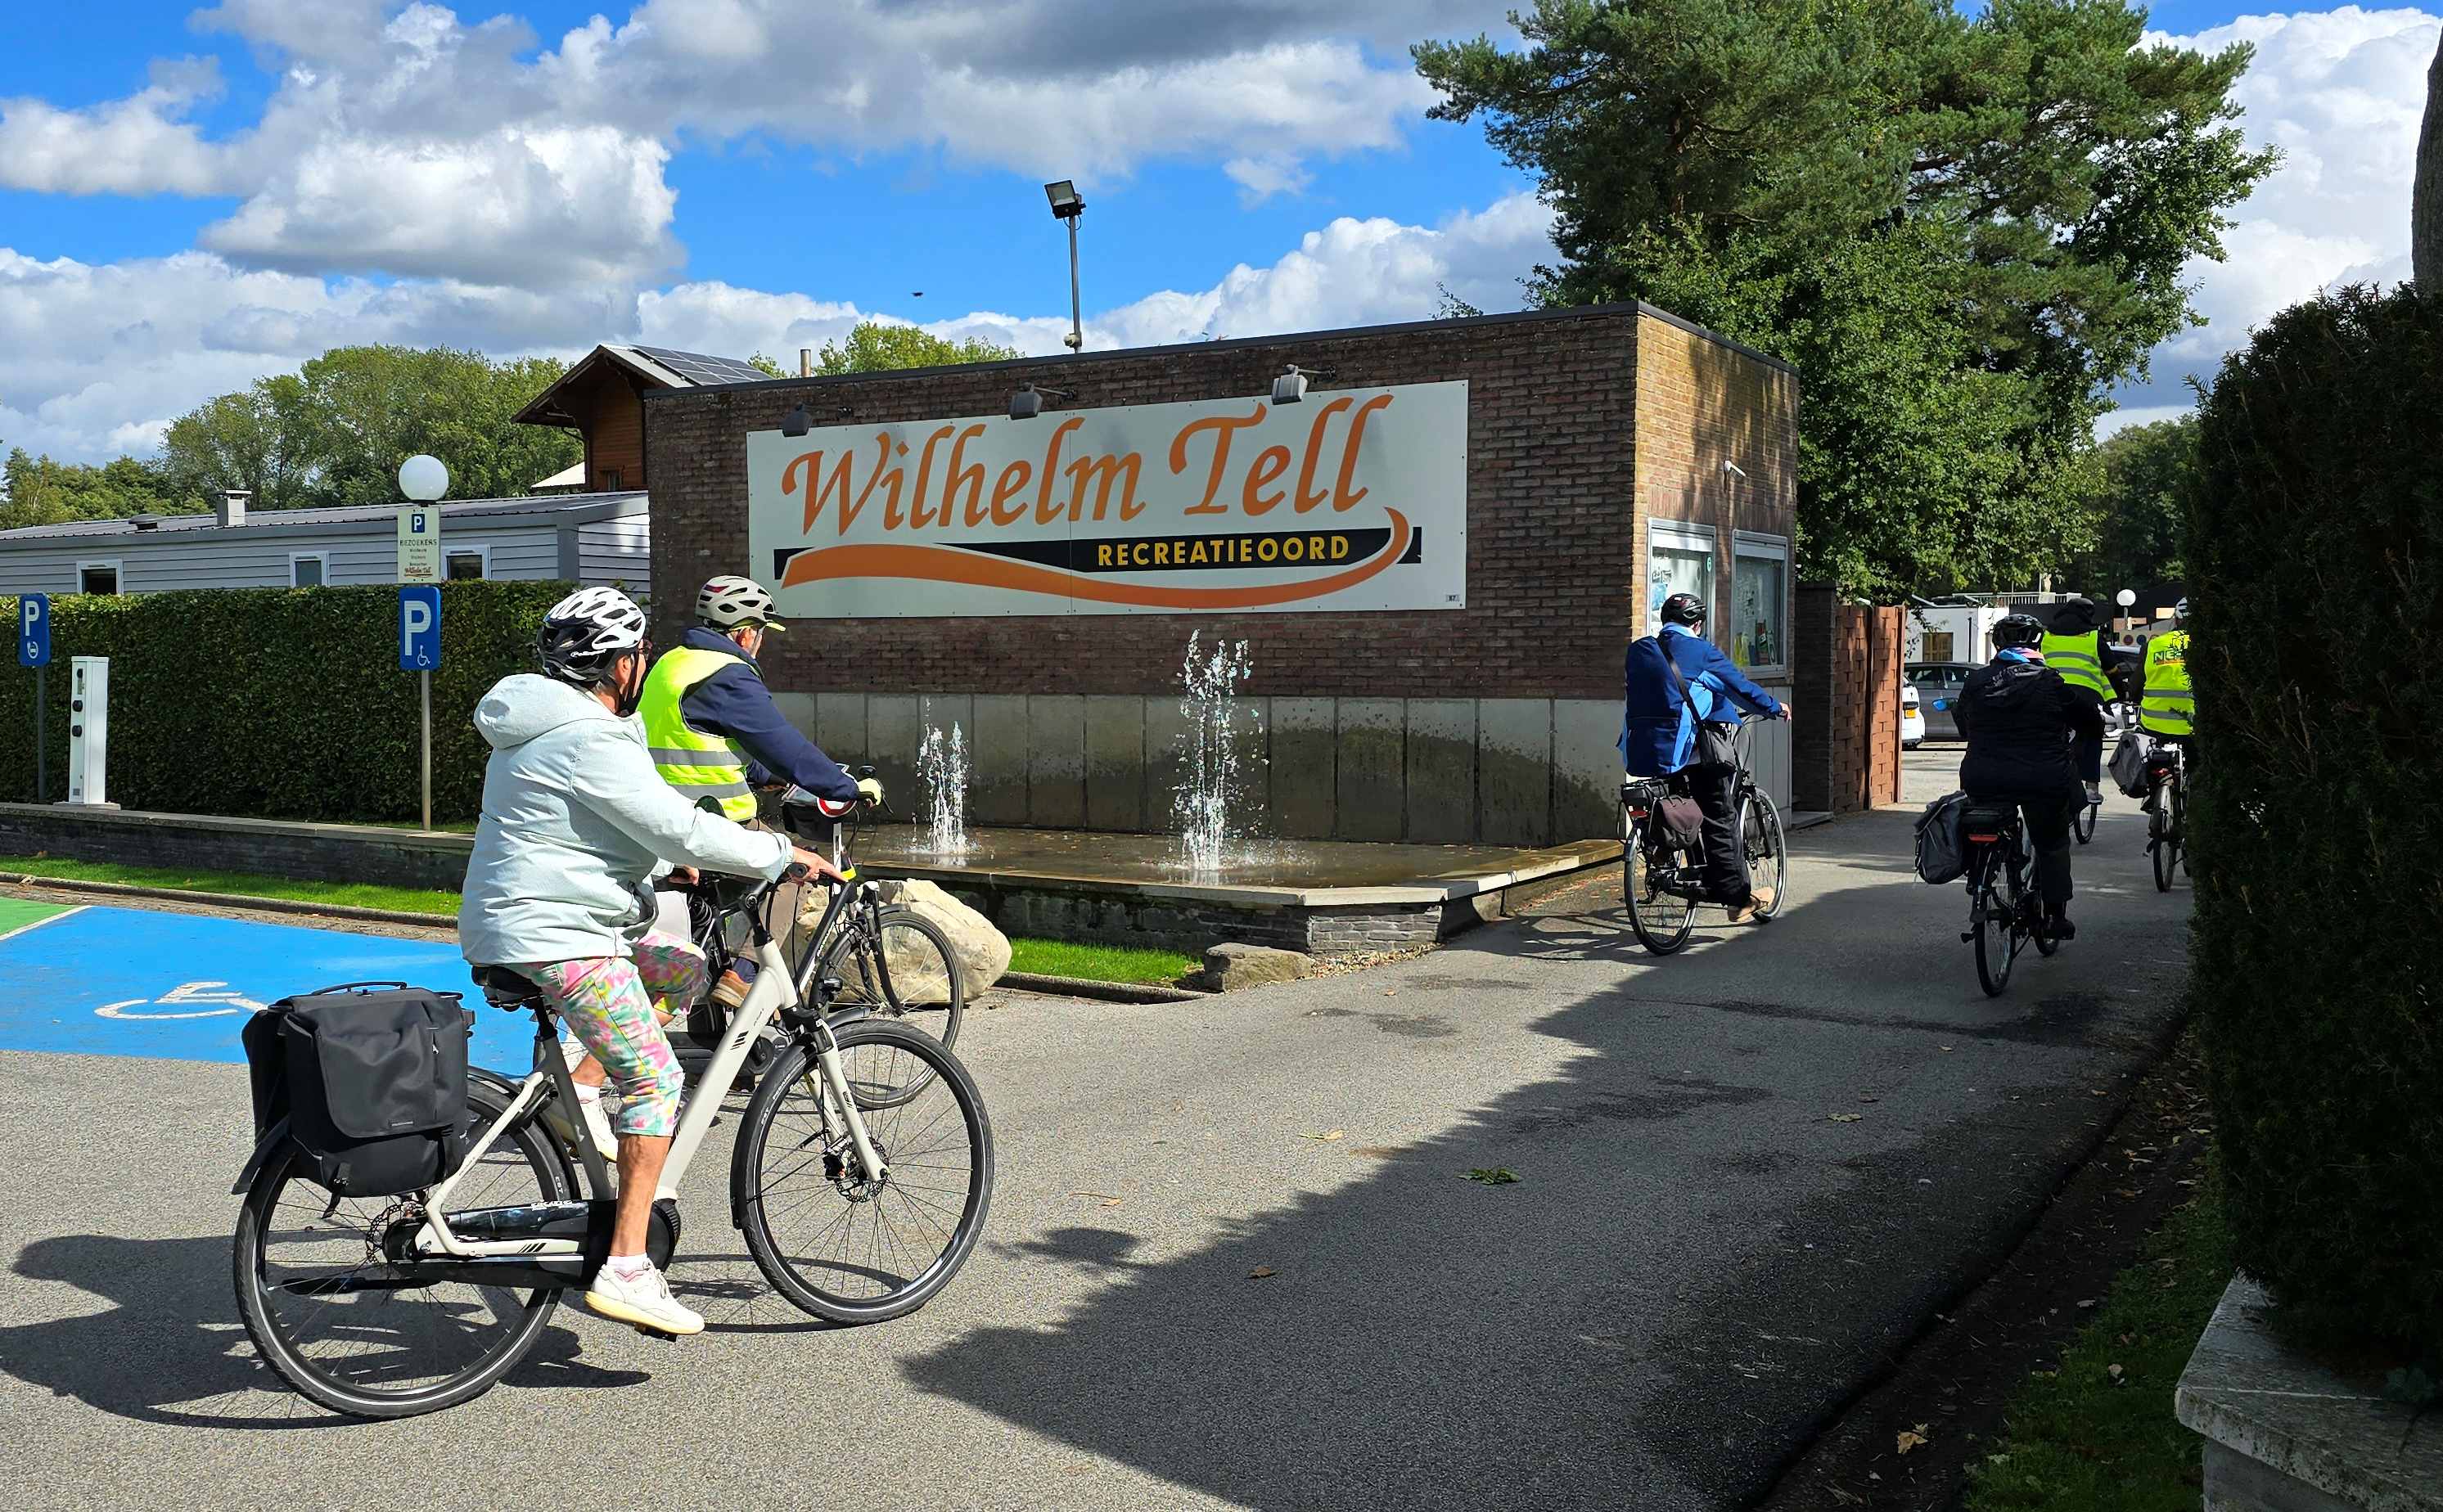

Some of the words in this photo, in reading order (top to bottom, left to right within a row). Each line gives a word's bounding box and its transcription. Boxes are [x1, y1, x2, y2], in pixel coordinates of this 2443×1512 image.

[782, 417, 1146, 537] Wilhelm
[1169, 394, 1395, 516] Tell
[413, 515, 422, 531] P
[399, 538, 438, 547] BEZOEKERS
[1098, 535, 1350, 566] RECREATIEOORD
[25, 601, 39, 636] P
[404, 601, 431, 655] P
